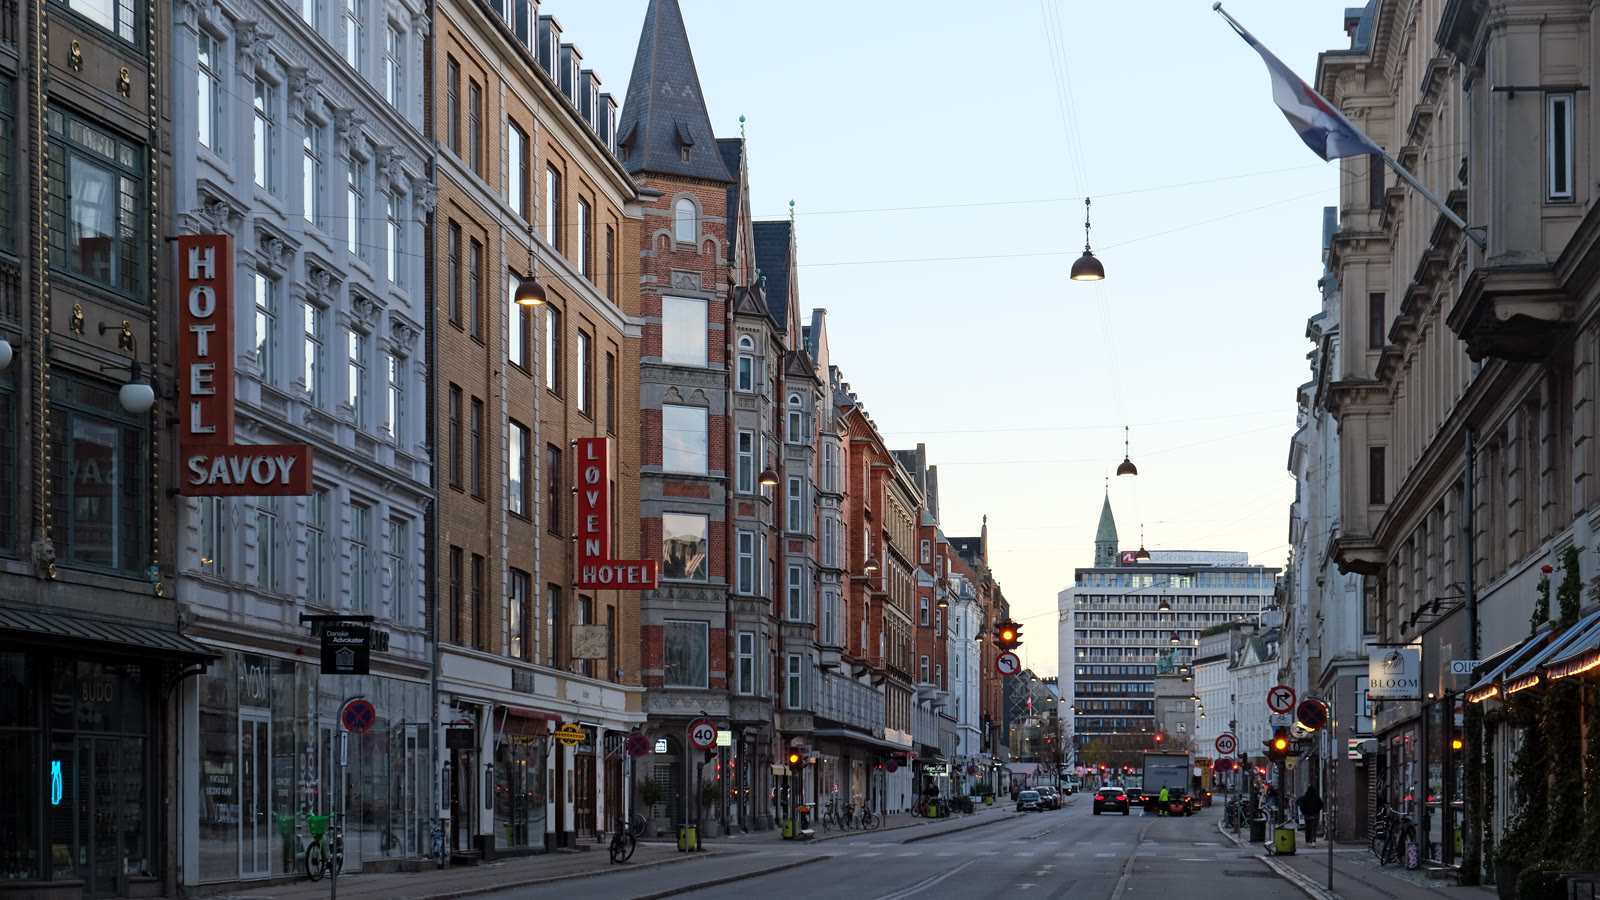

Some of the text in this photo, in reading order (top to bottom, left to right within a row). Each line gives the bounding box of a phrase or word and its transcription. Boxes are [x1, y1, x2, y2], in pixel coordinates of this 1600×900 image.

[188, 246, 216, 433] HOTEL
[187, 455, 296, 485] SAVOY
[585, 442, 600, 557] LØVEN
[583, 565, 653, 584] HOTEL
[1453, 661, 1480, 672] OLIS
[1370, 679, 1418, 688] BLOOM
[694, 729, 713, 741] 40
[1218, 740, 1232, 748] 40
[206, 786, 232, 796] SECOND HAND
